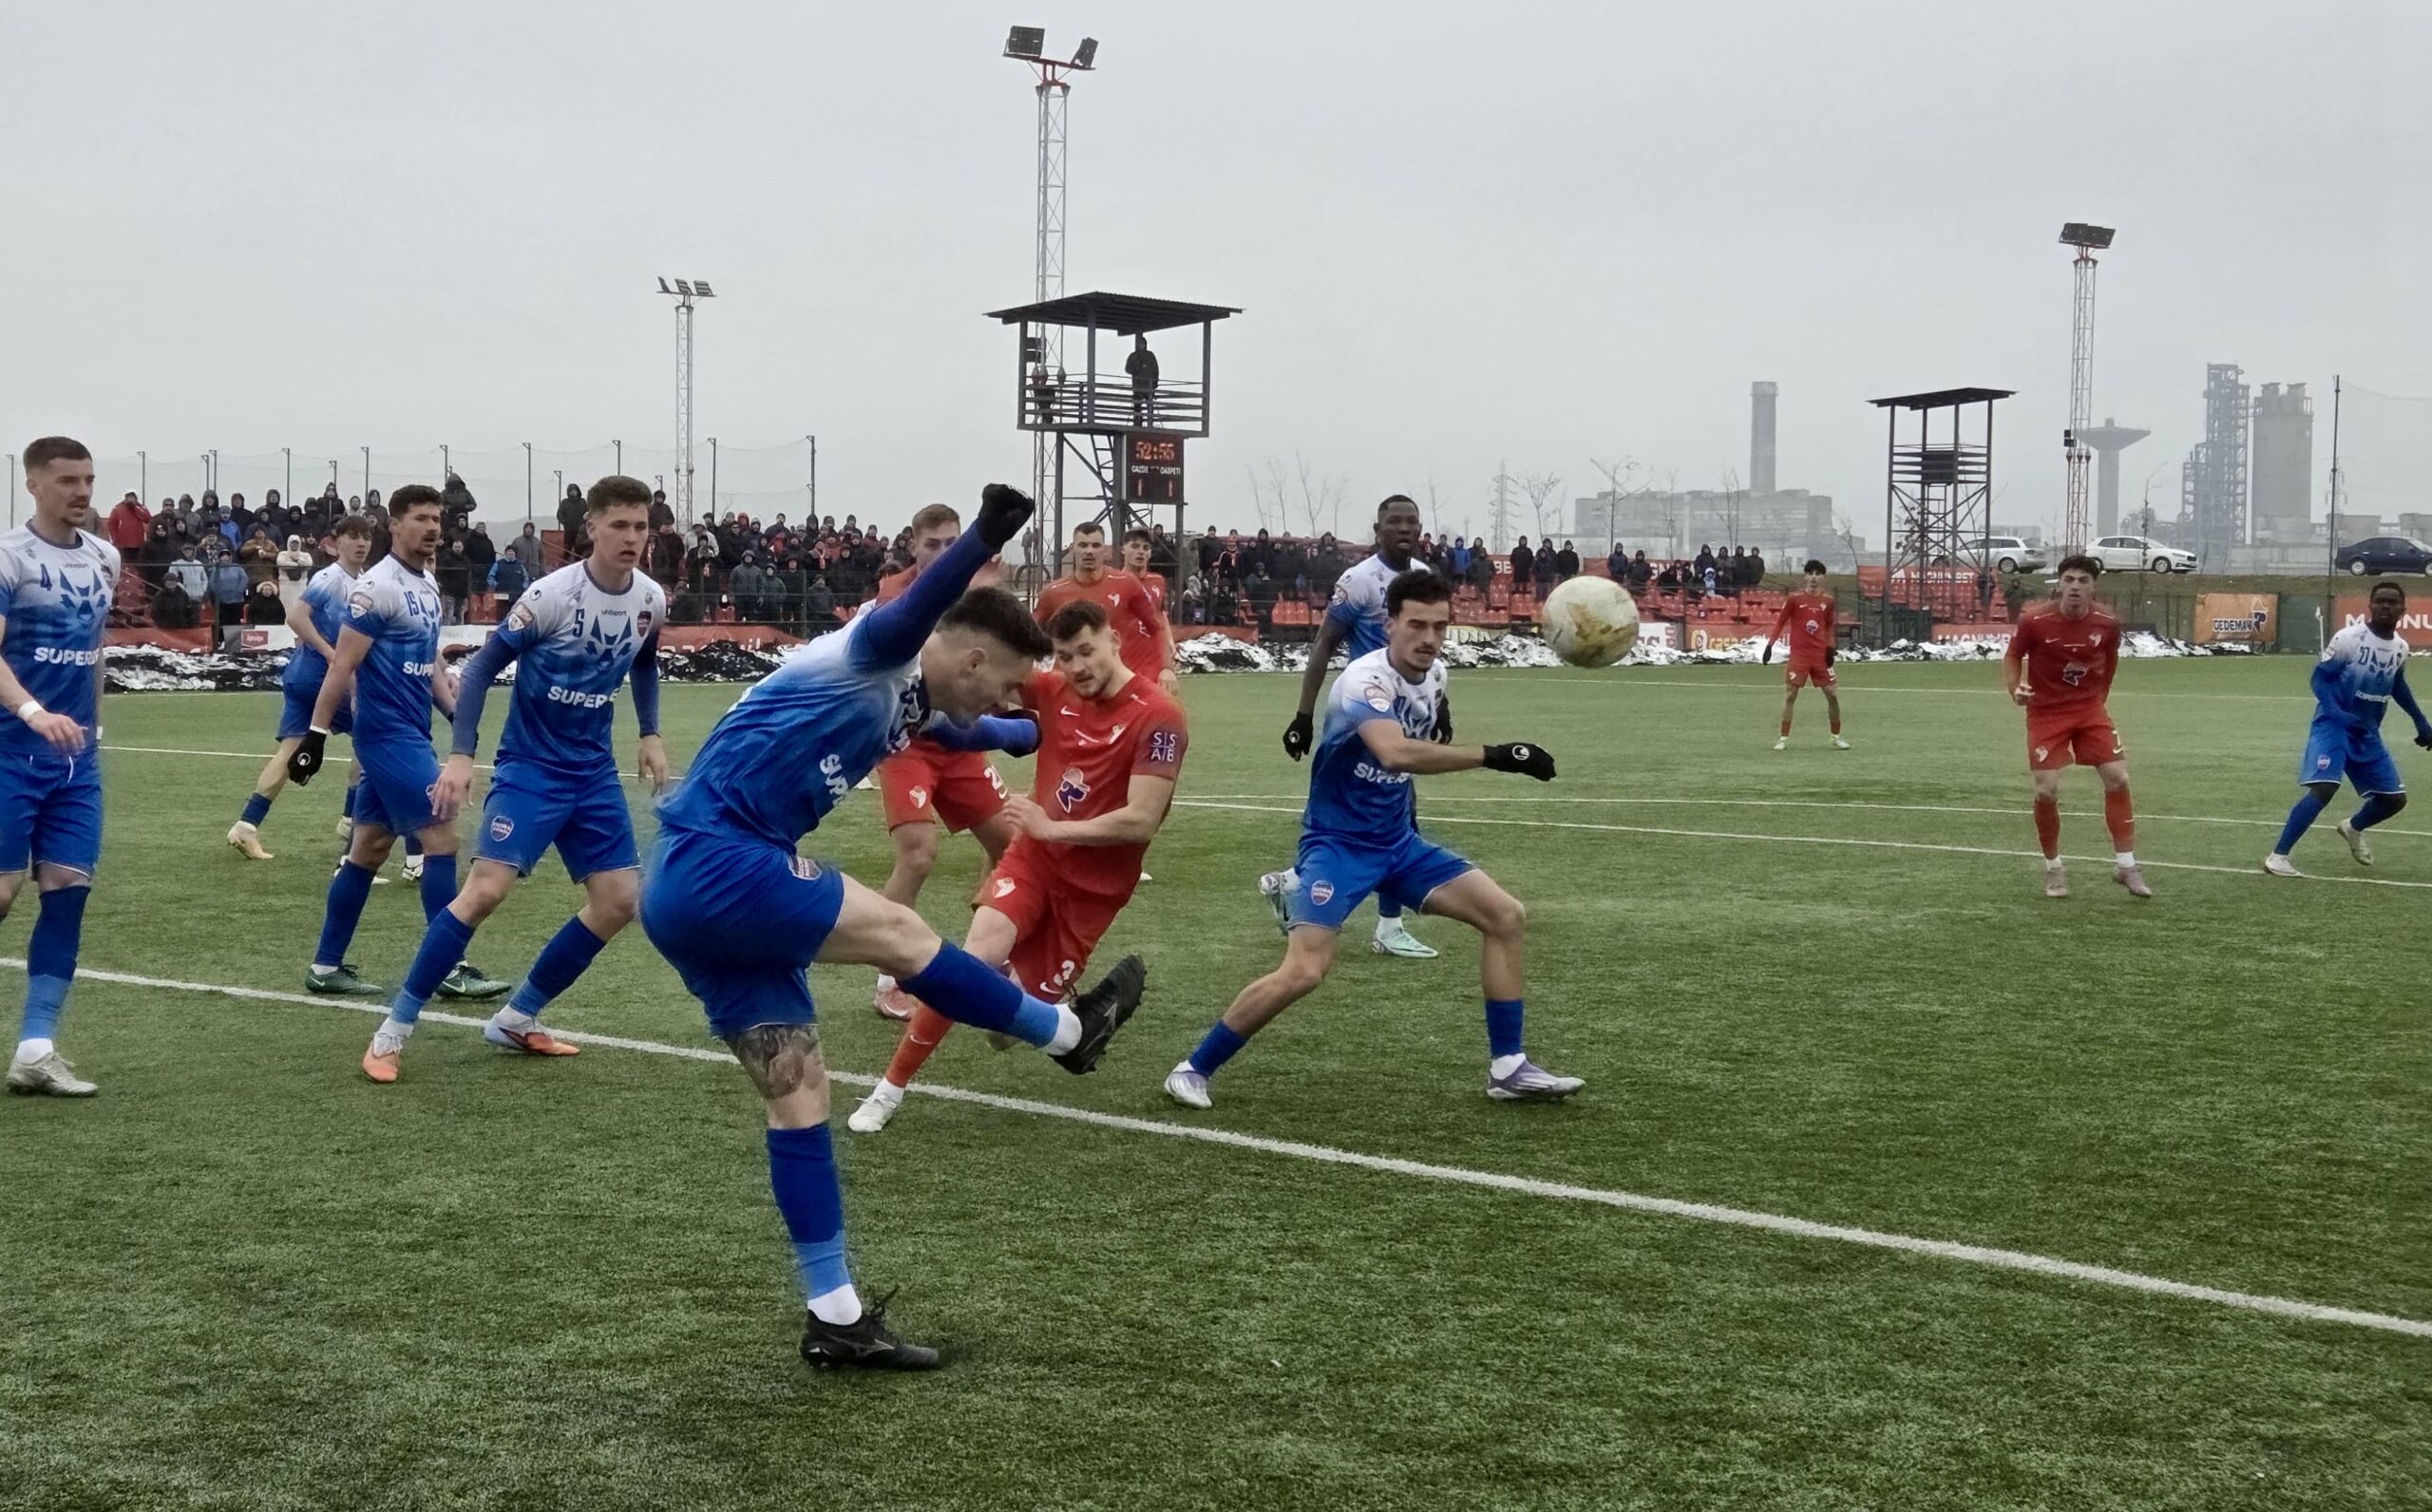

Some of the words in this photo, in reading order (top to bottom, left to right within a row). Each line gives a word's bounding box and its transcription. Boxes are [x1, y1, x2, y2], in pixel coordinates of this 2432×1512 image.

[40, 563, 52, 591] 4
[573, 608, 585, 637] 5
[2214, 619, 2252, 632] DEDEMAN
[1053, 959, 1075, 988] 3
